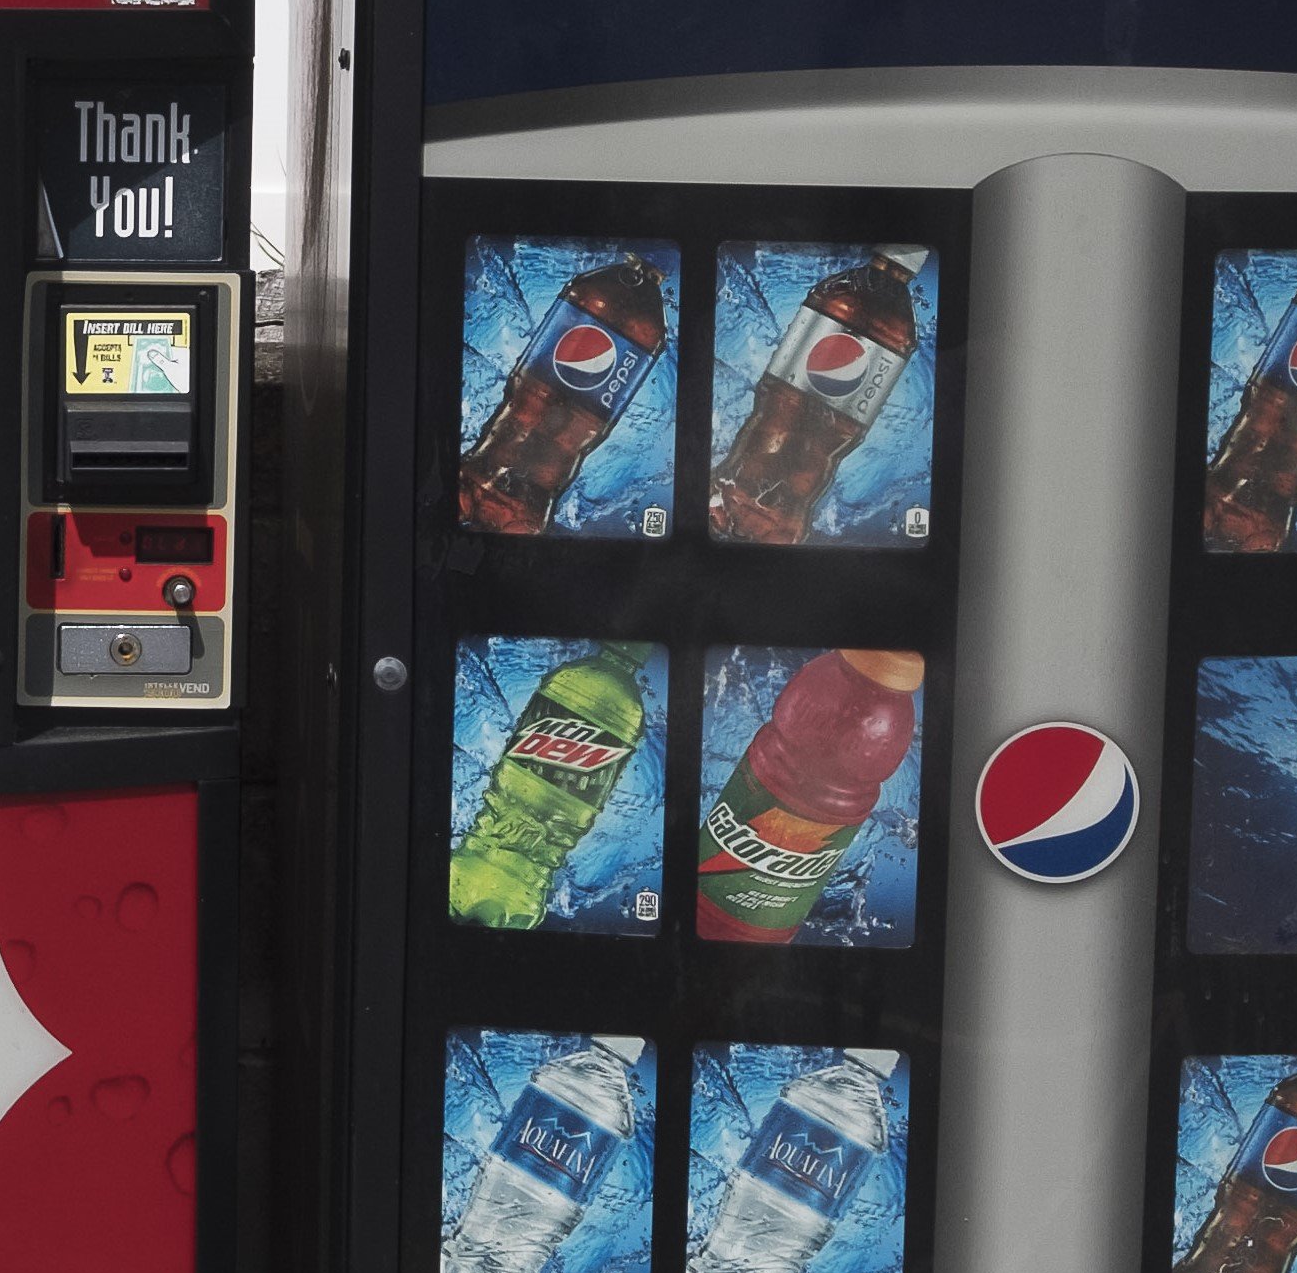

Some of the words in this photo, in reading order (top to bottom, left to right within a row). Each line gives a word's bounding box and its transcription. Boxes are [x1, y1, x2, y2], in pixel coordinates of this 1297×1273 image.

[74, 101, 191, 164] Thank
[601, 350, 639, 409] pepsi
[857, 355, 893, 414] pepsi
[639, 894, 657, 906] 290
[512, 1117, 596, 1184] AQUAFINA
[766, 1131, 846, 1199] AQUAFINA
